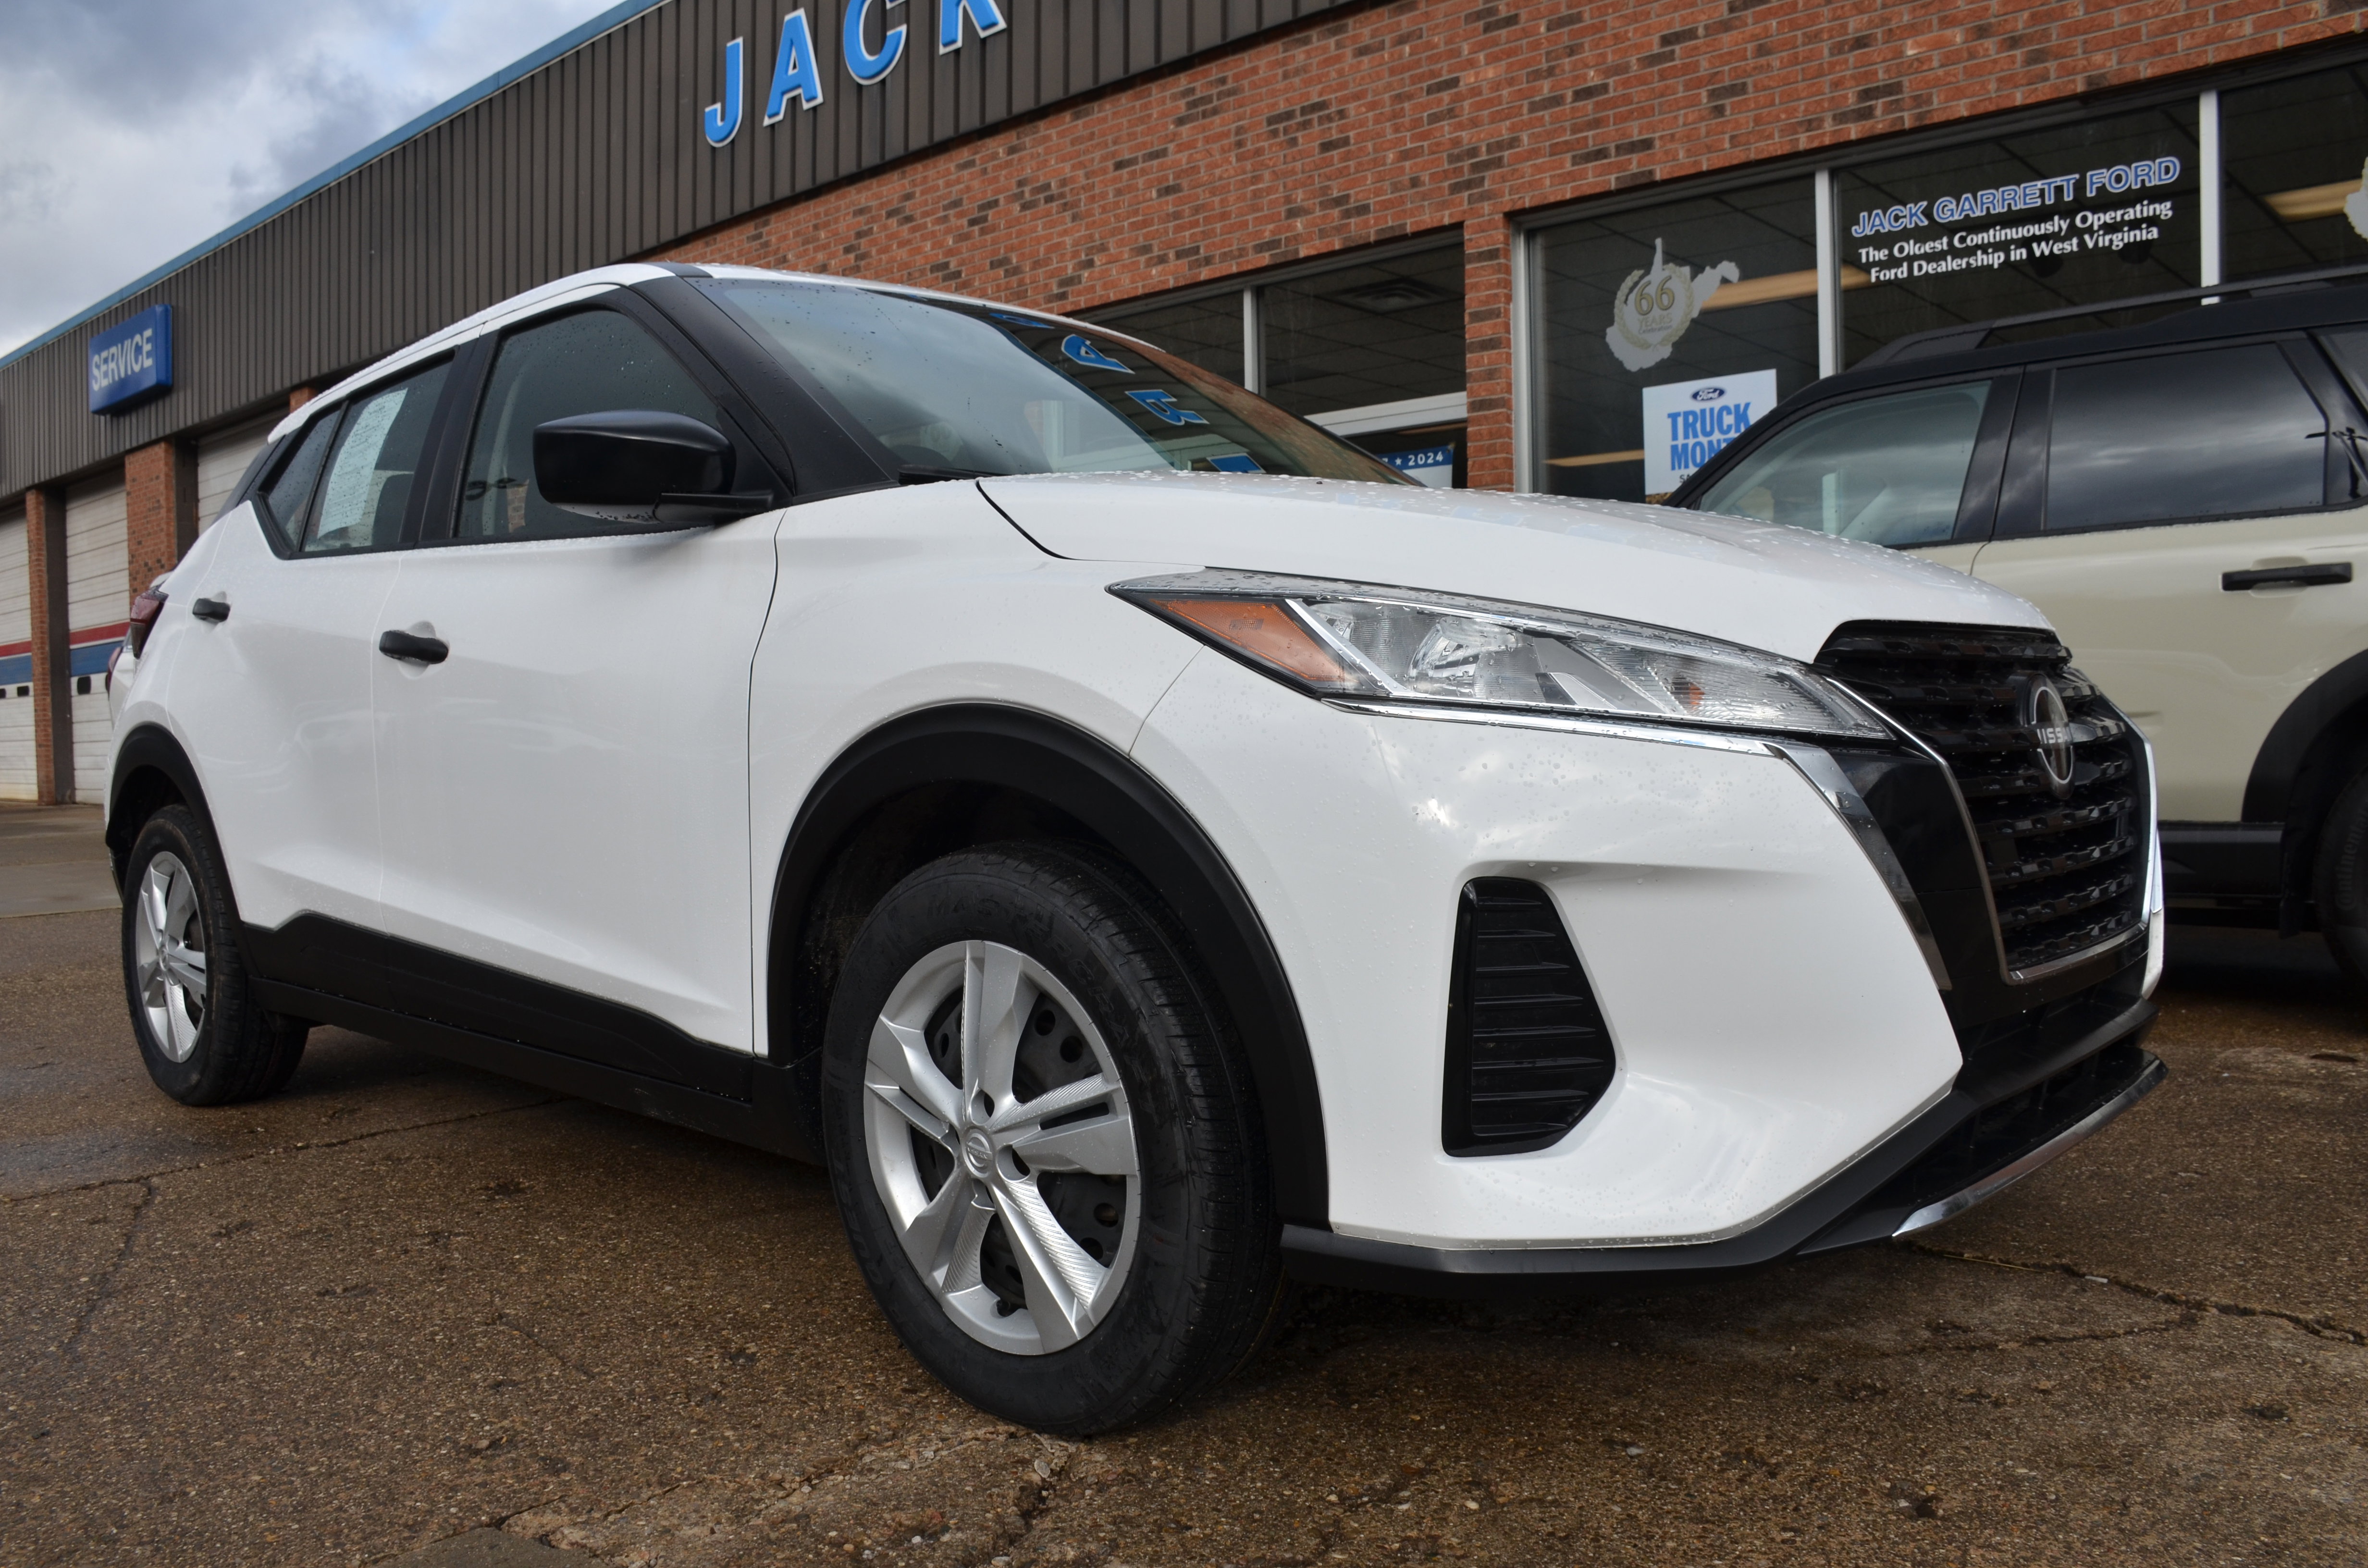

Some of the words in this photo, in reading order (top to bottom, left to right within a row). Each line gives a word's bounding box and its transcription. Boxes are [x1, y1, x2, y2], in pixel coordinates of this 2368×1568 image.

[1851, 202, 1928, 237] JACK
[1933, 173, 2080, 224] GARRETT
[2086, 156, 2181, 197] FORD
[1858, 247, 1889, 264] The
[1893, 239, 1949, 258] Oldest
[1953, 215, 2070, 248] Continuously
[2075, 200, 2173, 228] Operating
[1870, 266, 1908, 283] Ford
[1913, 251, 2005, 276] Dealership
[2010, 244, 2027, 261] in
[2032, 237, 2078, 257] West
[2084, 225, 2159, 250] Virginia
[1635, 275, 1675, 316] 66
[1637, 312, 1673, 328] YEARS
[92, 328, 153, 392] SERVICE
[1696, 388, 1720, 401] Ford
[1667, 402, 1751, 442] TRUCK
[1408, 452, 1443, 466] 2024
[1671, 437, 1736, 471] MON
[830, 1150, 885, 1290] QUEST
